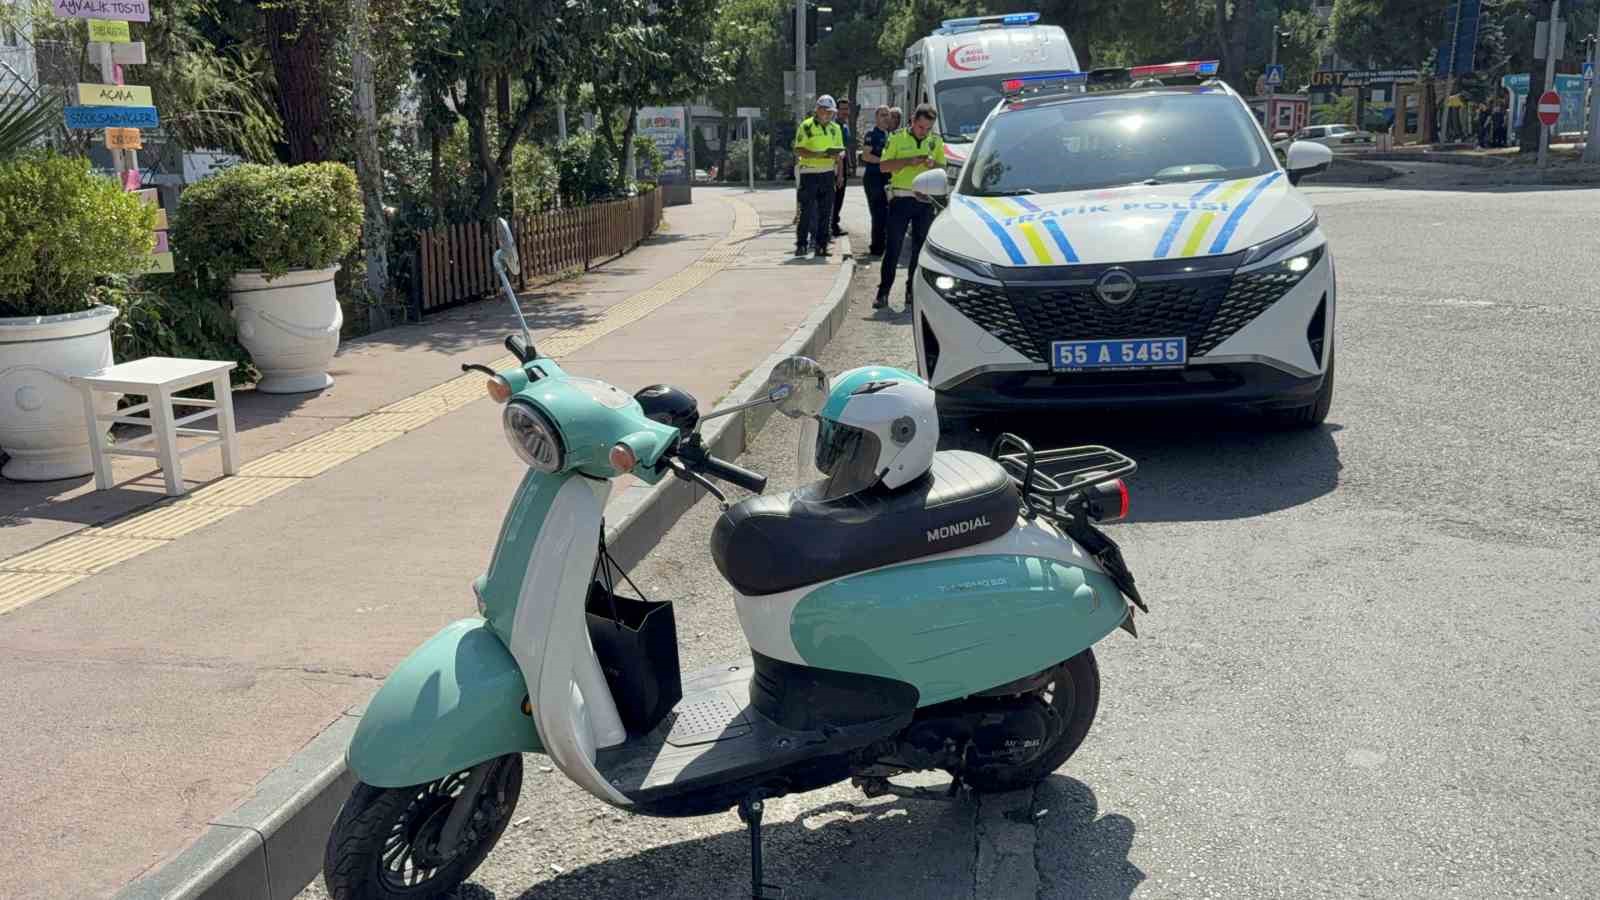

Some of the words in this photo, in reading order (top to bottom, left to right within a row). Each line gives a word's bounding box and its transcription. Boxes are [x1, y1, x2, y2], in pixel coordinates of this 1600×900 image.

[1060, 346, 1087, 364] 55
[1098, 344, 1111, 362] A
[1121, 342, 1179, 361] 5455
[926, 515, 991, 543] MONDIAL
